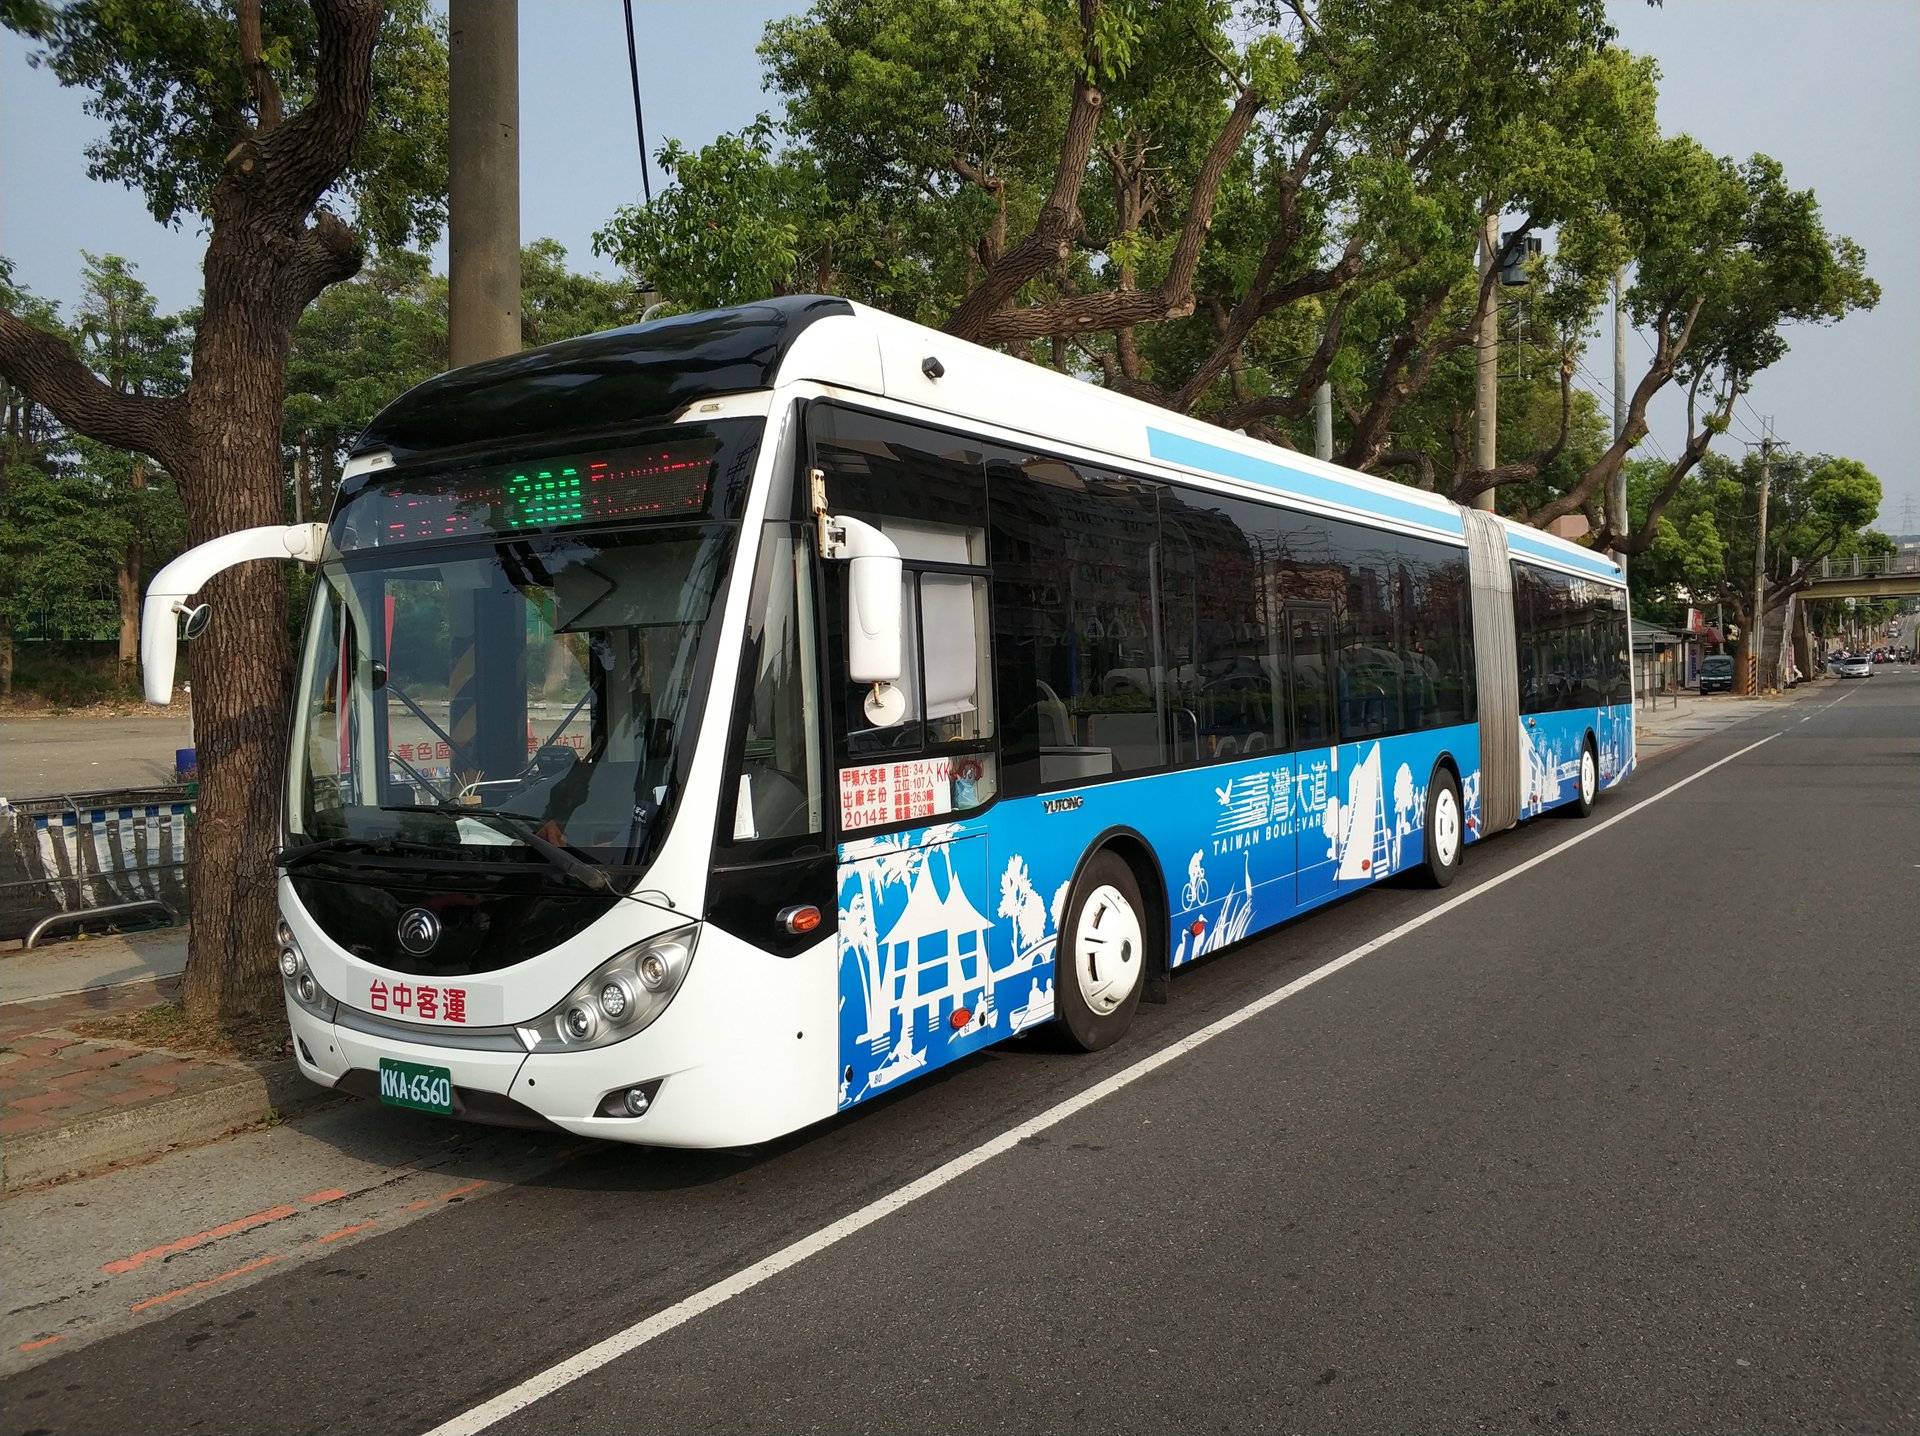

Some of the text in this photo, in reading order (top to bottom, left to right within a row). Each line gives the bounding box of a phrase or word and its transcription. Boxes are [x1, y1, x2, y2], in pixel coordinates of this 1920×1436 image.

[841, 767, 887, 788] 甲類大客車
[843, 786, 888, 809] 出廠年份
[1043, 796, 1084, 814] YUTONG
[844, 806, 889, 829] 2014年
[1213, 811, 1327, 856] TAIWAN BOULEVARD
[369, 978, 467, 1024] 台中客運
